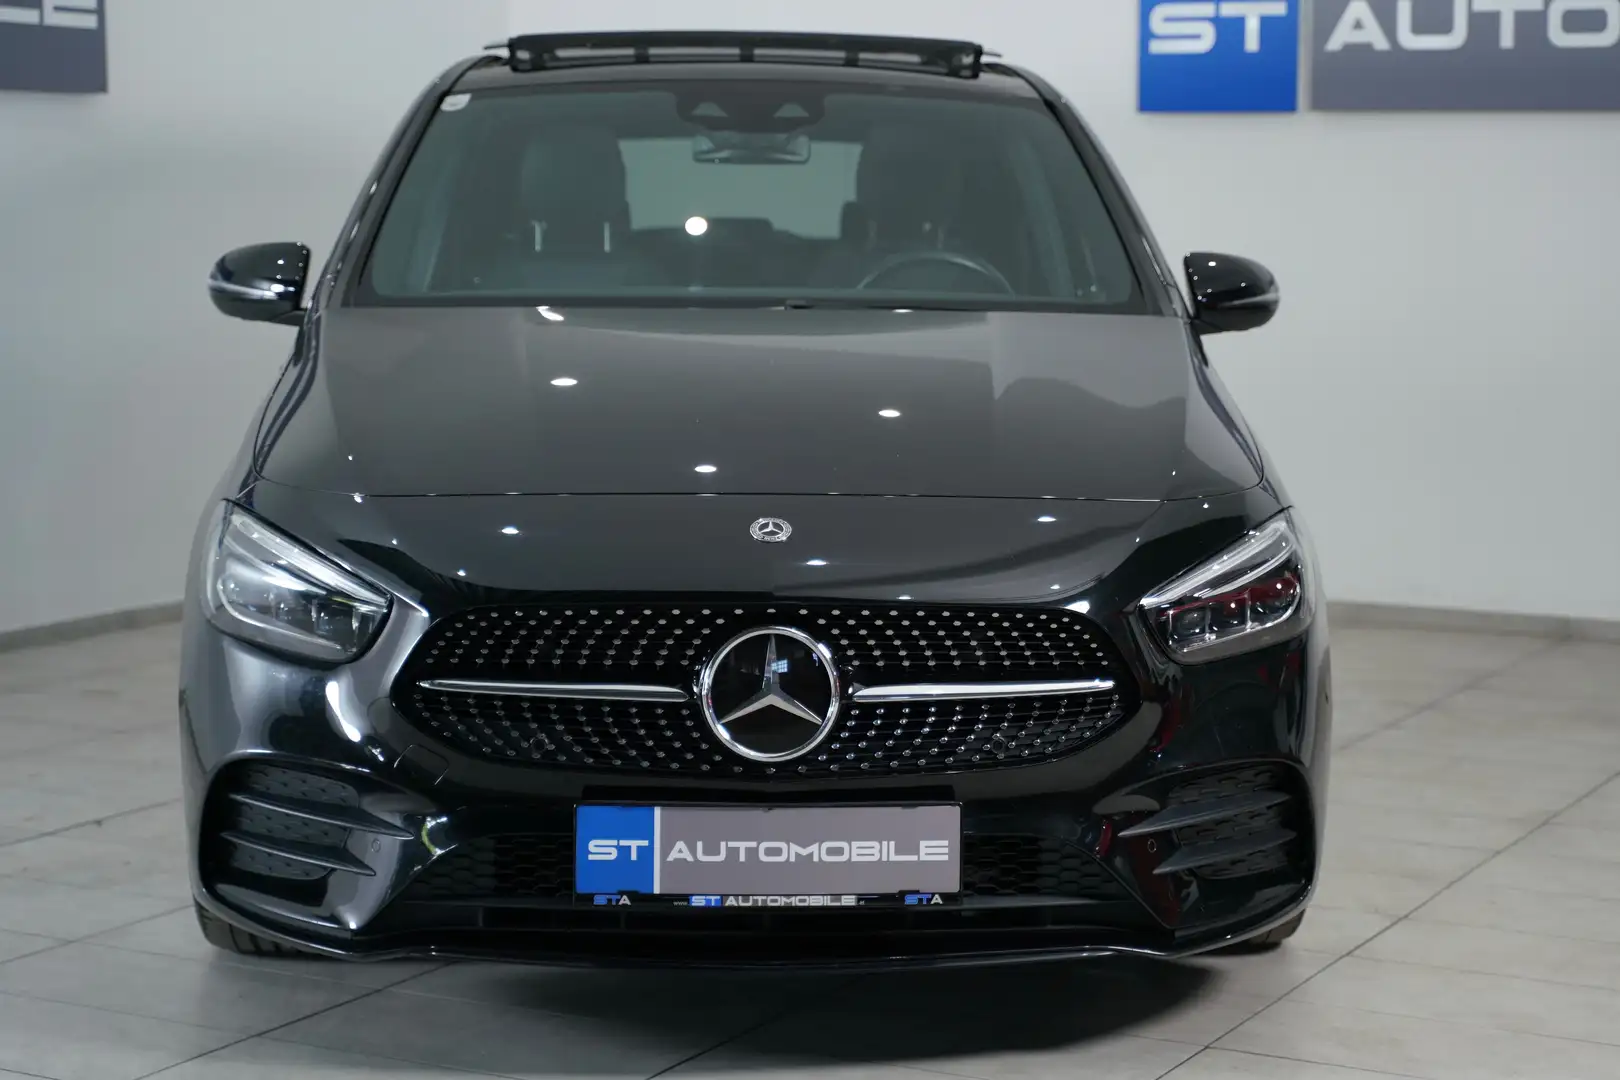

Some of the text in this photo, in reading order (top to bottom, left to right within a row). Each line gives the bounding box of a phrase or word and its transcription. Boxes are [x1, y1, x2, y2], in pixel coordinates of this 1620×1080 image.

[1148, 0, 1620, 54] ST AUTO
[588, 839, 949, 862] ST AUTOMOBILE
[593, 894, 631, 906] STA
[691, 895, 720, 906] ST
[725, 895, 856, 906] AUTOMOBILE
[904, 894, 943, 905] STA
